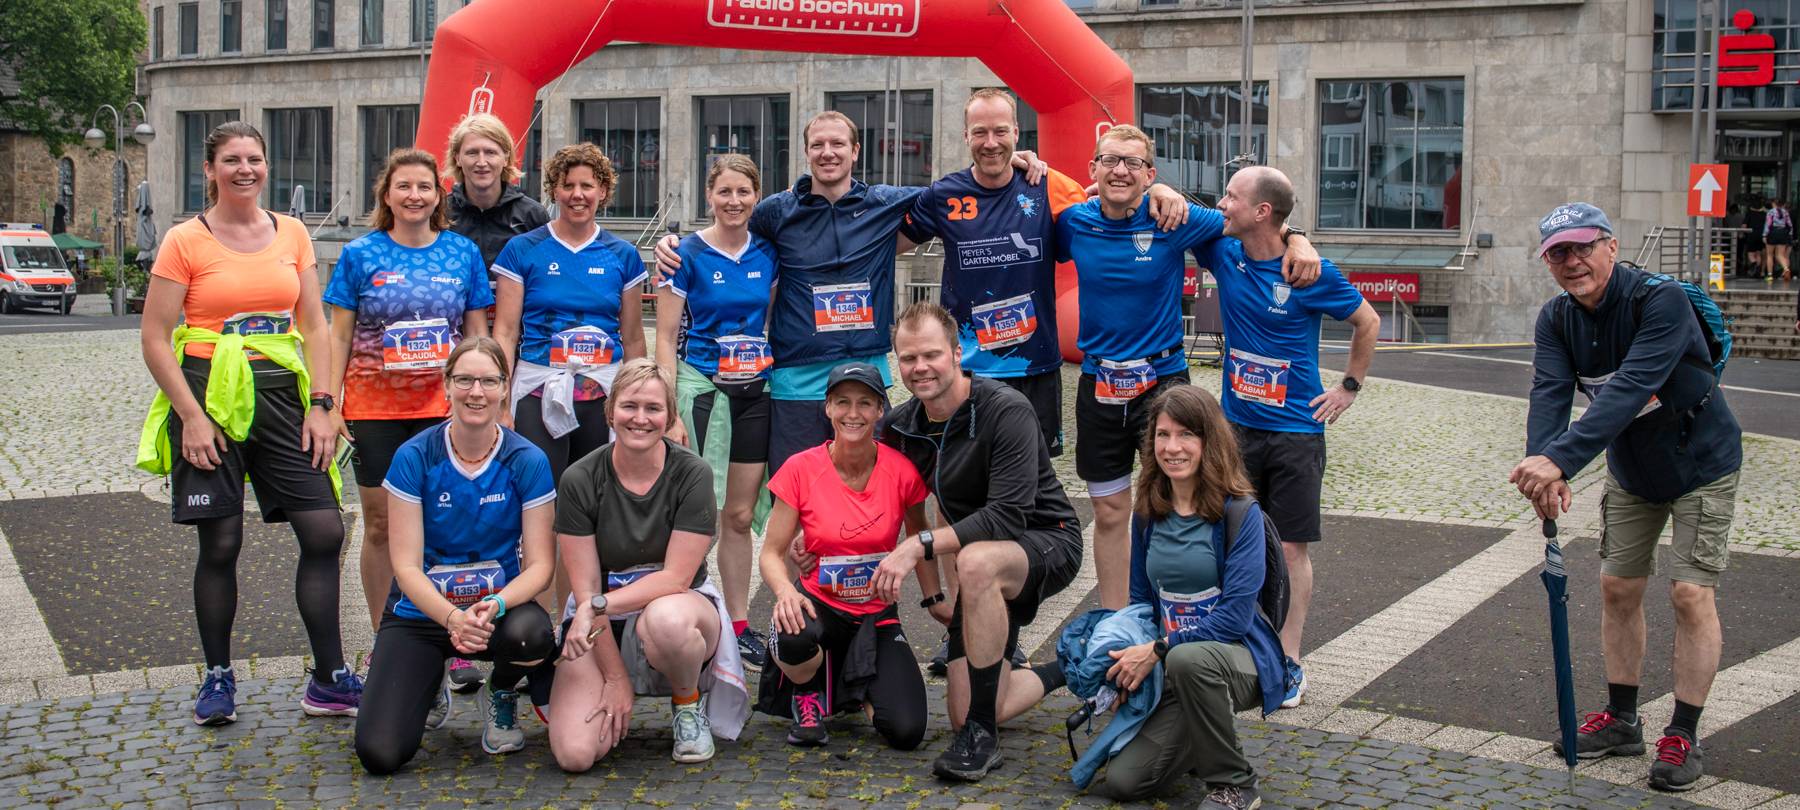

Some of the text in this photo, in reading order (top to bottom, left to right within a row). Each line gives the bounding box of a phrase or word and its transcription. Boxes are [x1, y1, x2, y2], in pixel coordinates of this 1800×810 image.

[725, 0, 904, 17] radio bochum
[947, 196, 978, 220] 23
[964, 252, 1020, 265] GARTENMÖBEL
[431, 276, 456, 284] CRAFT
[838, 303, 857, 312] 1346
[1268, 306, 1288, 315] Fabian
[831, 314, 863, 322] MICHAEL
[996, 319, 1016, 329] 1355
[996, 328, 1021, 340] ANDRE
[408, 341, 430, 350] 1324
[575, 344, 594, 352] 1321
[401, 352, 437, 361] CLAUDIA
[1115, 379, 1136, 388] 2156
[1243, 374, 1264, 386] 4485
[1114, 389, 1139, 397] ANDRE
[1238, 383, 1266, 396] FABIAN
[188, 494, 210, 506] MG
[844, 577, 867, 587] 1380
[455, 586, 479, 596] 1353
[838, 588, 873, 596] VERENA
